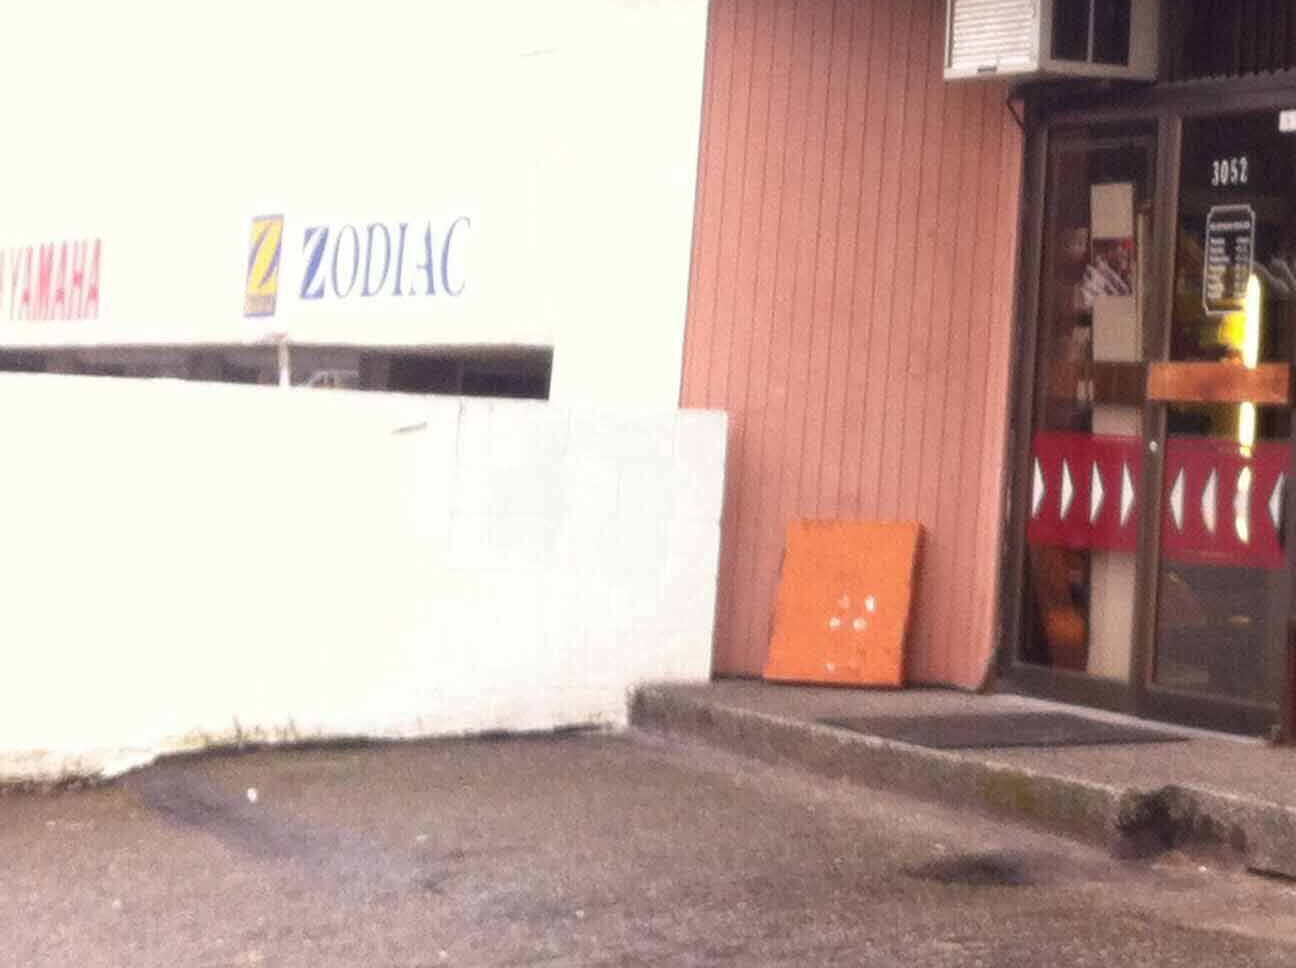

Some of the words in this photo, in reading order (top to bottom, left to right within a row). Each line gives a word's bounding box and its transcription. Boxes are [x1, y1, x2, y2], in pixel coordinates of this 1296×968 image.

[1211, 156, 1249, 187] 3052
[9, 237, 102, 321] YAMAHA
[299, 216, 472, 300] ZODIAC
